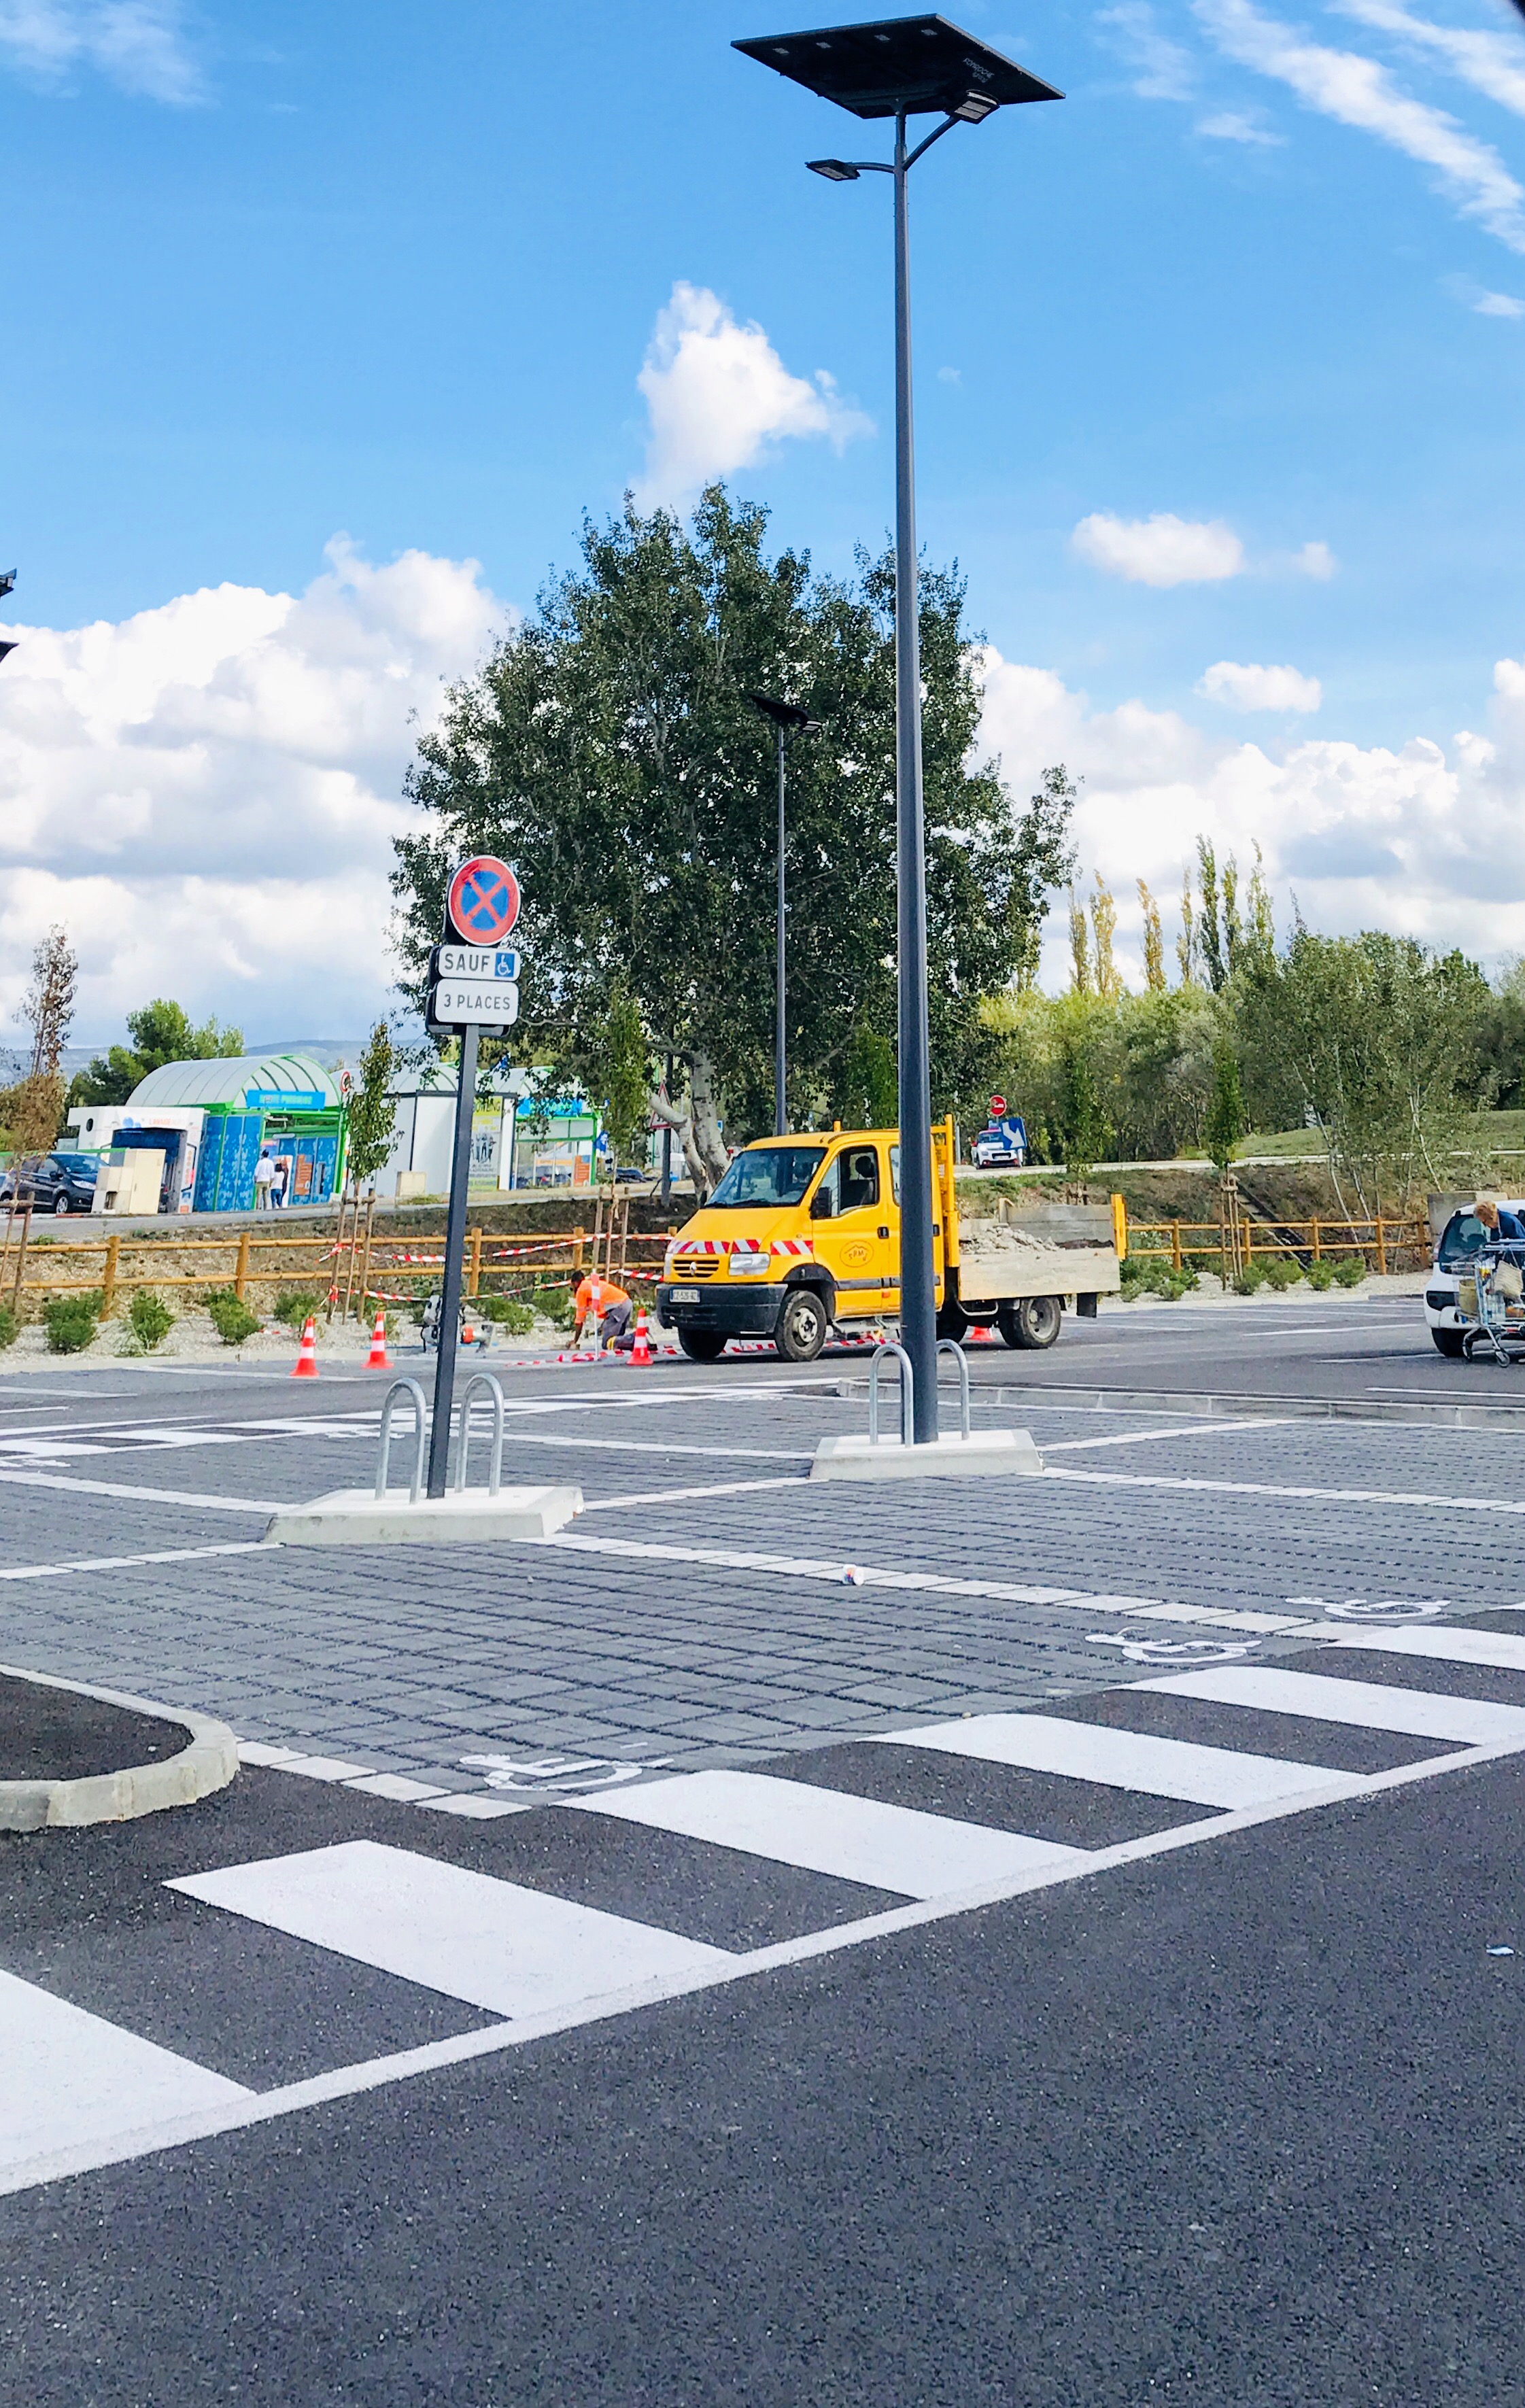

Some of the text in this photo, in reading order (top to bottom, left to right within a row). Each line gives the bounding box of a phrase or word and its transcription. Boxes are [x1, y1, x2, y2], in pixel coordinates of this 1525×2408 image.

[444, 952, 490, 972] SAUF
[444, 994, 511, 1010] 3 PLACES
